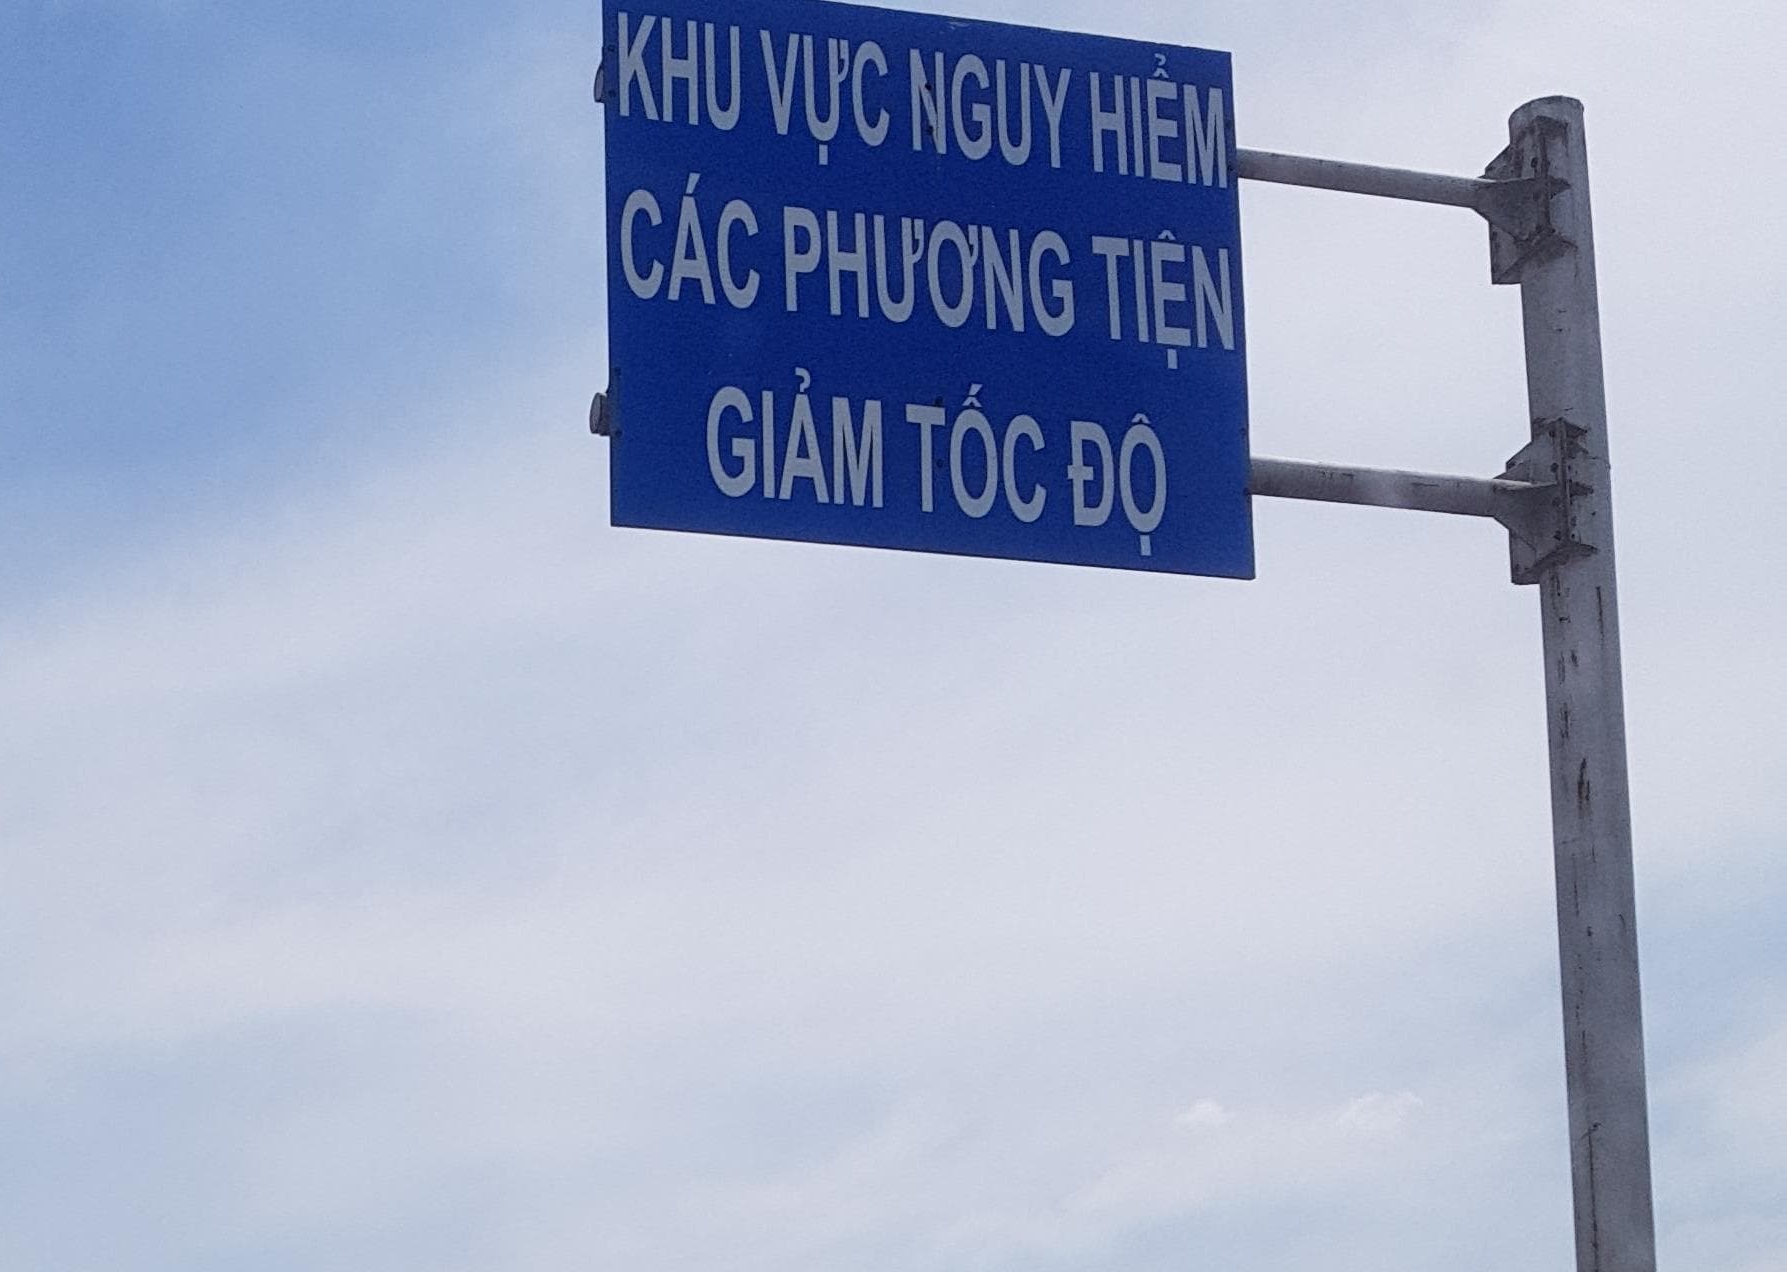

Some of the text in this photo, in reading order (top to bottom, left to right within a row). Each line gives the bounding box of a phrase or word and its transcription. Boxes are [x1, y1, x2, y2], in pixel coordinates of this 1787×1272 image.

[618, 11, 1229, 190] KHU VỰC NGUY HIỂM
[620, 172, 1236, 370] CÁC PHƯƠNG TIỆN
[706, 366, 1167, 556] GIẢM TỐC ĐỘ
